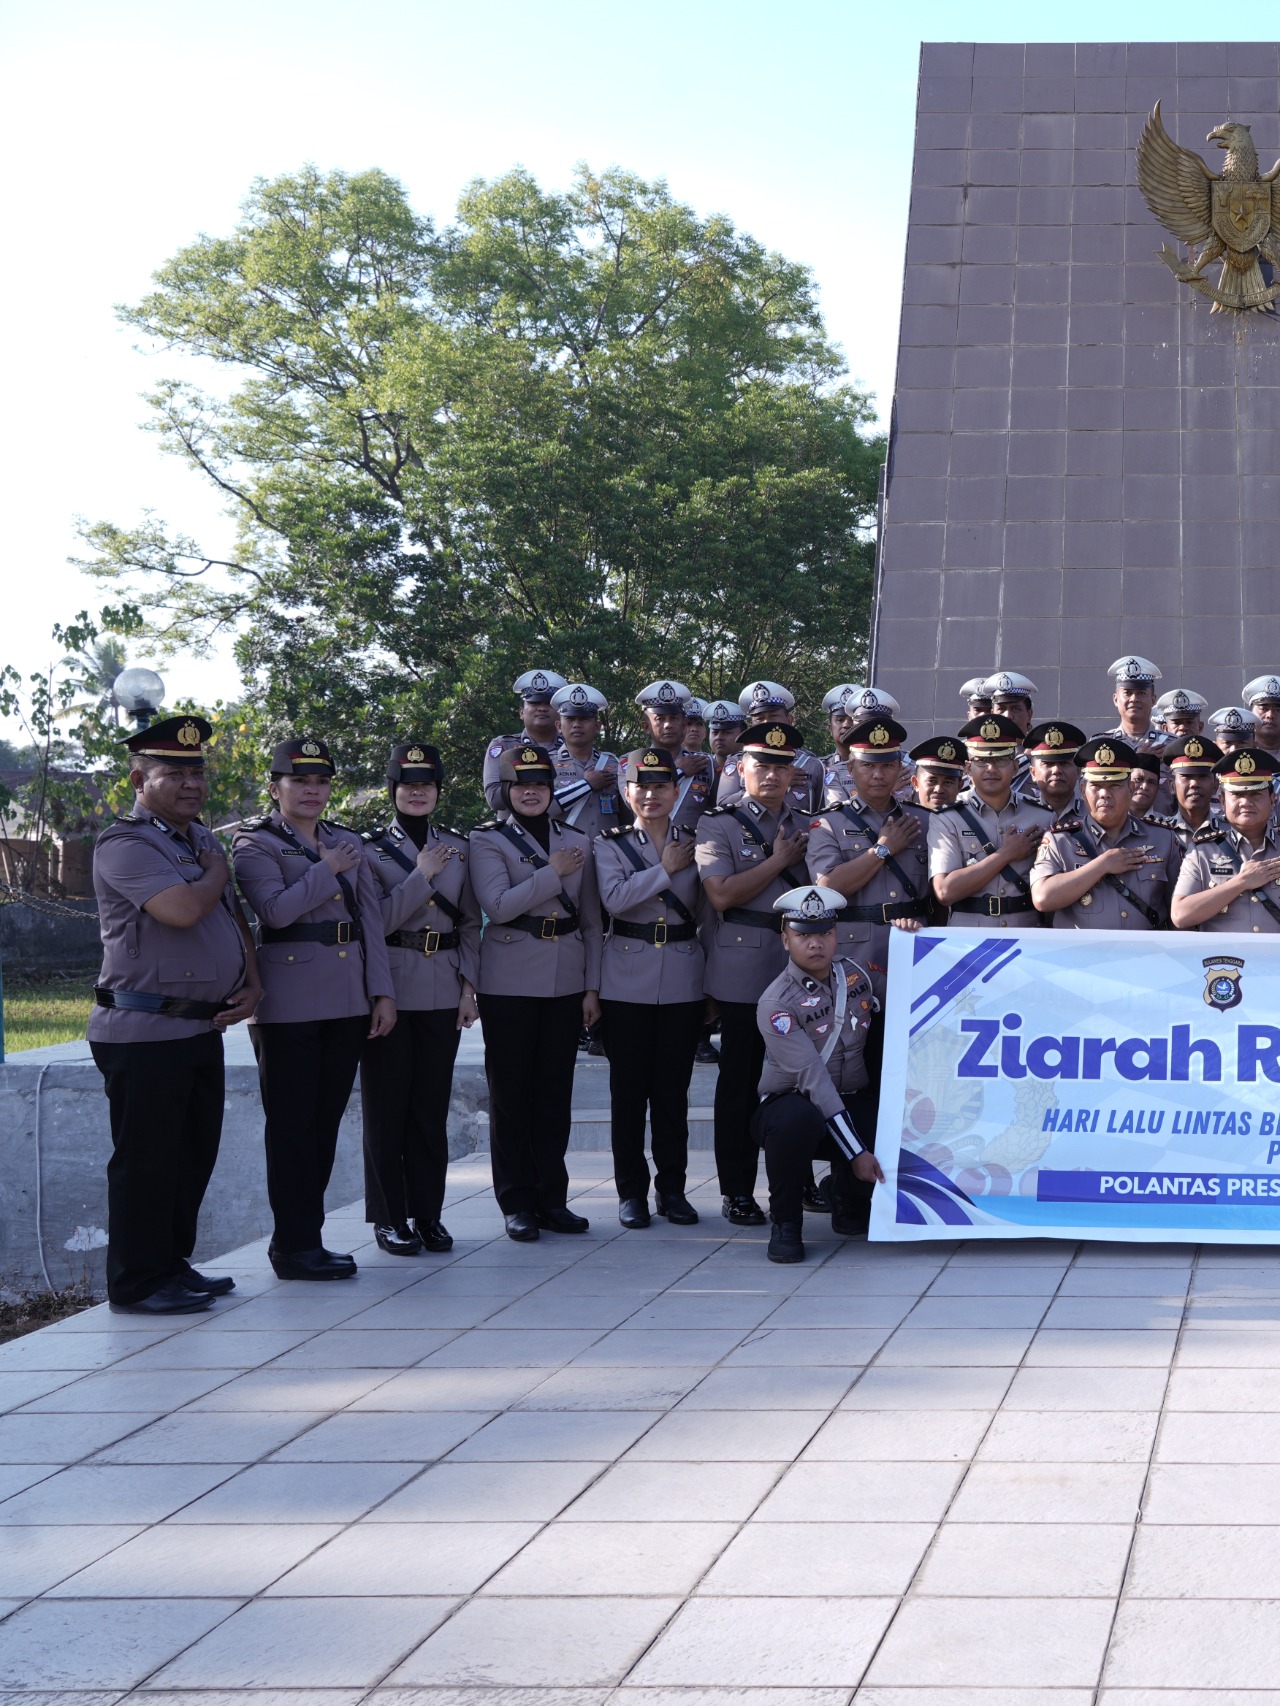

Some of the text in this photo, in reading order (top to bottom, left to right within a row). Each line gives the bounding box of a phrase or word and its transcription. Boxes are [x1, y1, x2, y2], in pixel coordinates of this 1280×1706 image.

[805, 1005, 831, 1024] ALIF
[957, 1012, 1222, 1080] Ziarah
[1041, 1108, 1101, 1133] HARI
[1106, 1109, 1166, 1134] LALU
[1171, 1110, 1253, 1136] LINTAS
[1099, 1175, 1221, 1196] POLANTAS
